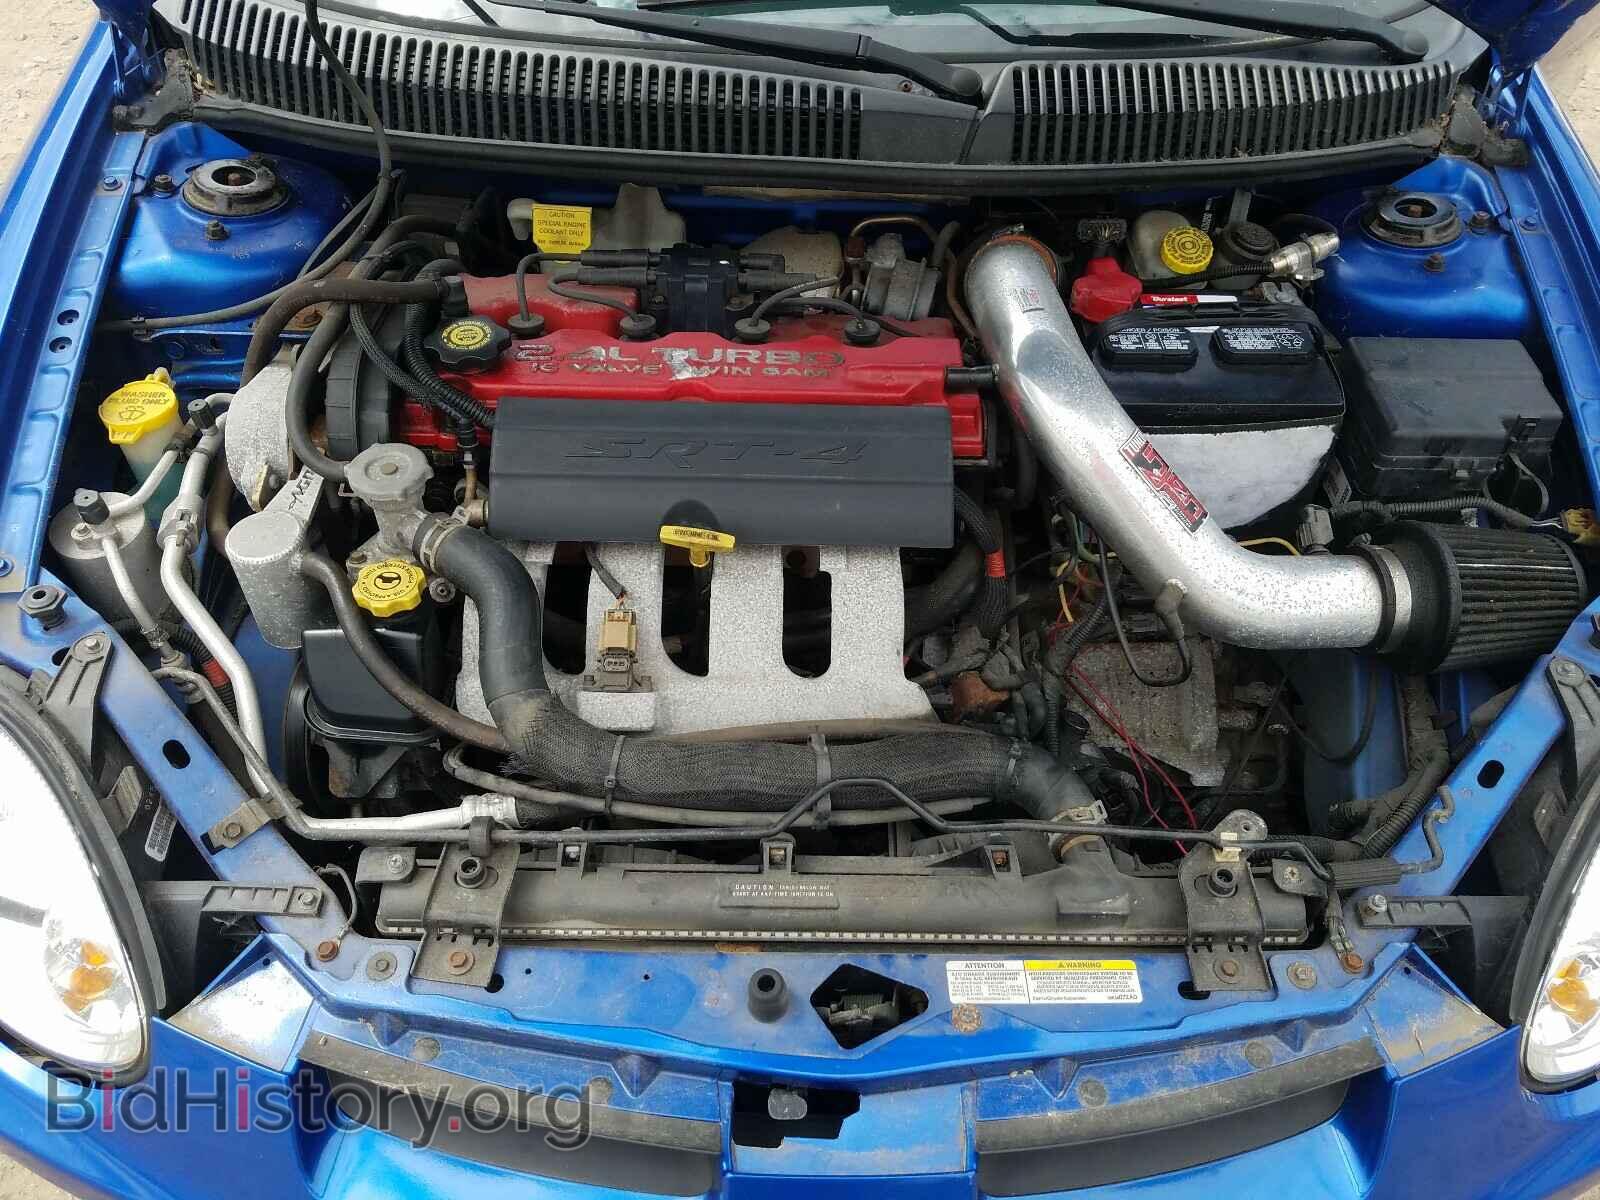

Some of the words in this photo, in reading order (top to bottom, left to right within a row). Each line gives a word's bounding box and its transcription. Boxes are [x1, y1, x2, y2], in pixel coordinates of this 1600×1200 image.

[537, 219, 562, 227] SPECIAL
[652, 346, 845, 367] TURBO
[568, 362, 663, 375] VALVE
[562, 436, 870, 470] SRT-4
